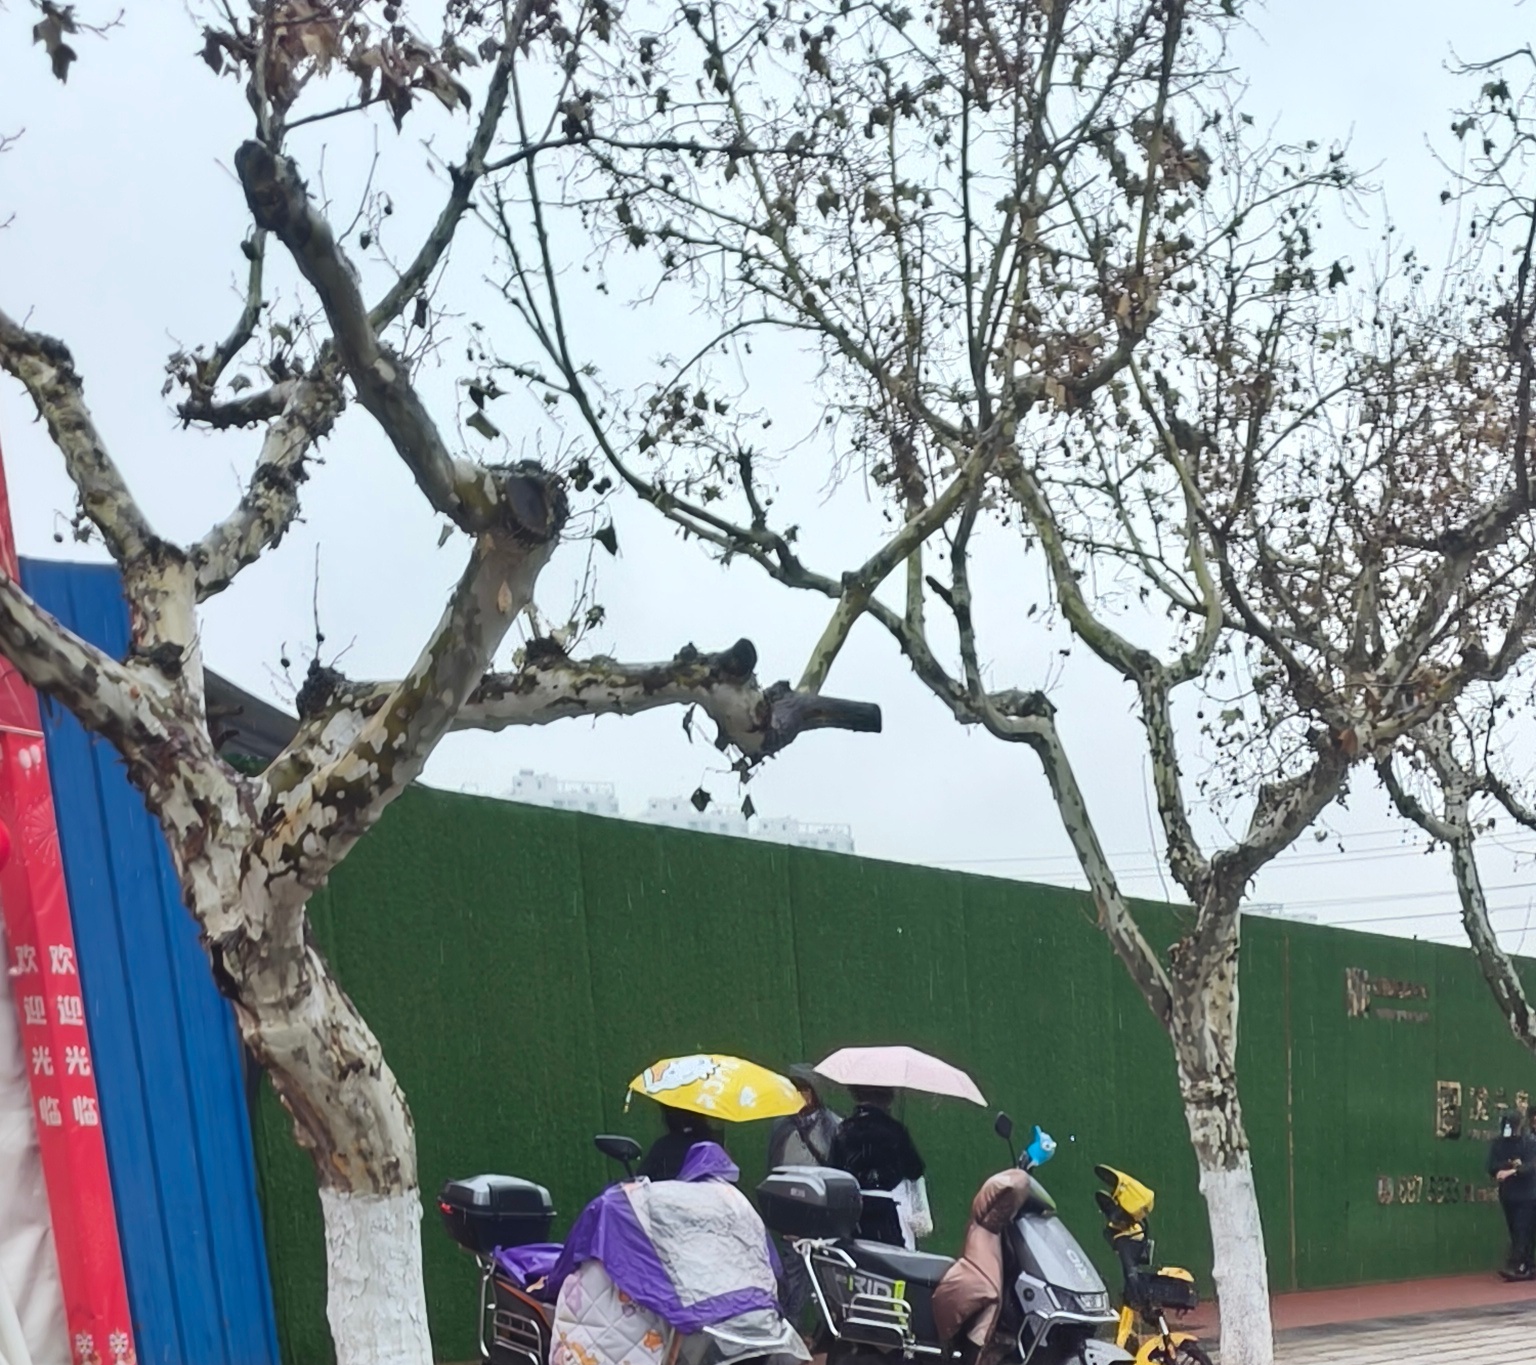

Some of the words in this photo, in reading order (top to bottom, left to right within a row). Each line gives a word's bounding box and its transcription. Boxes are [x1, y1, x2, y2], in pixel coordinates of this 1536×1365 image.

[15, 944, 62, 1127] 欢迎光临
[49, 943, 99, 1127] 欢迎光临
